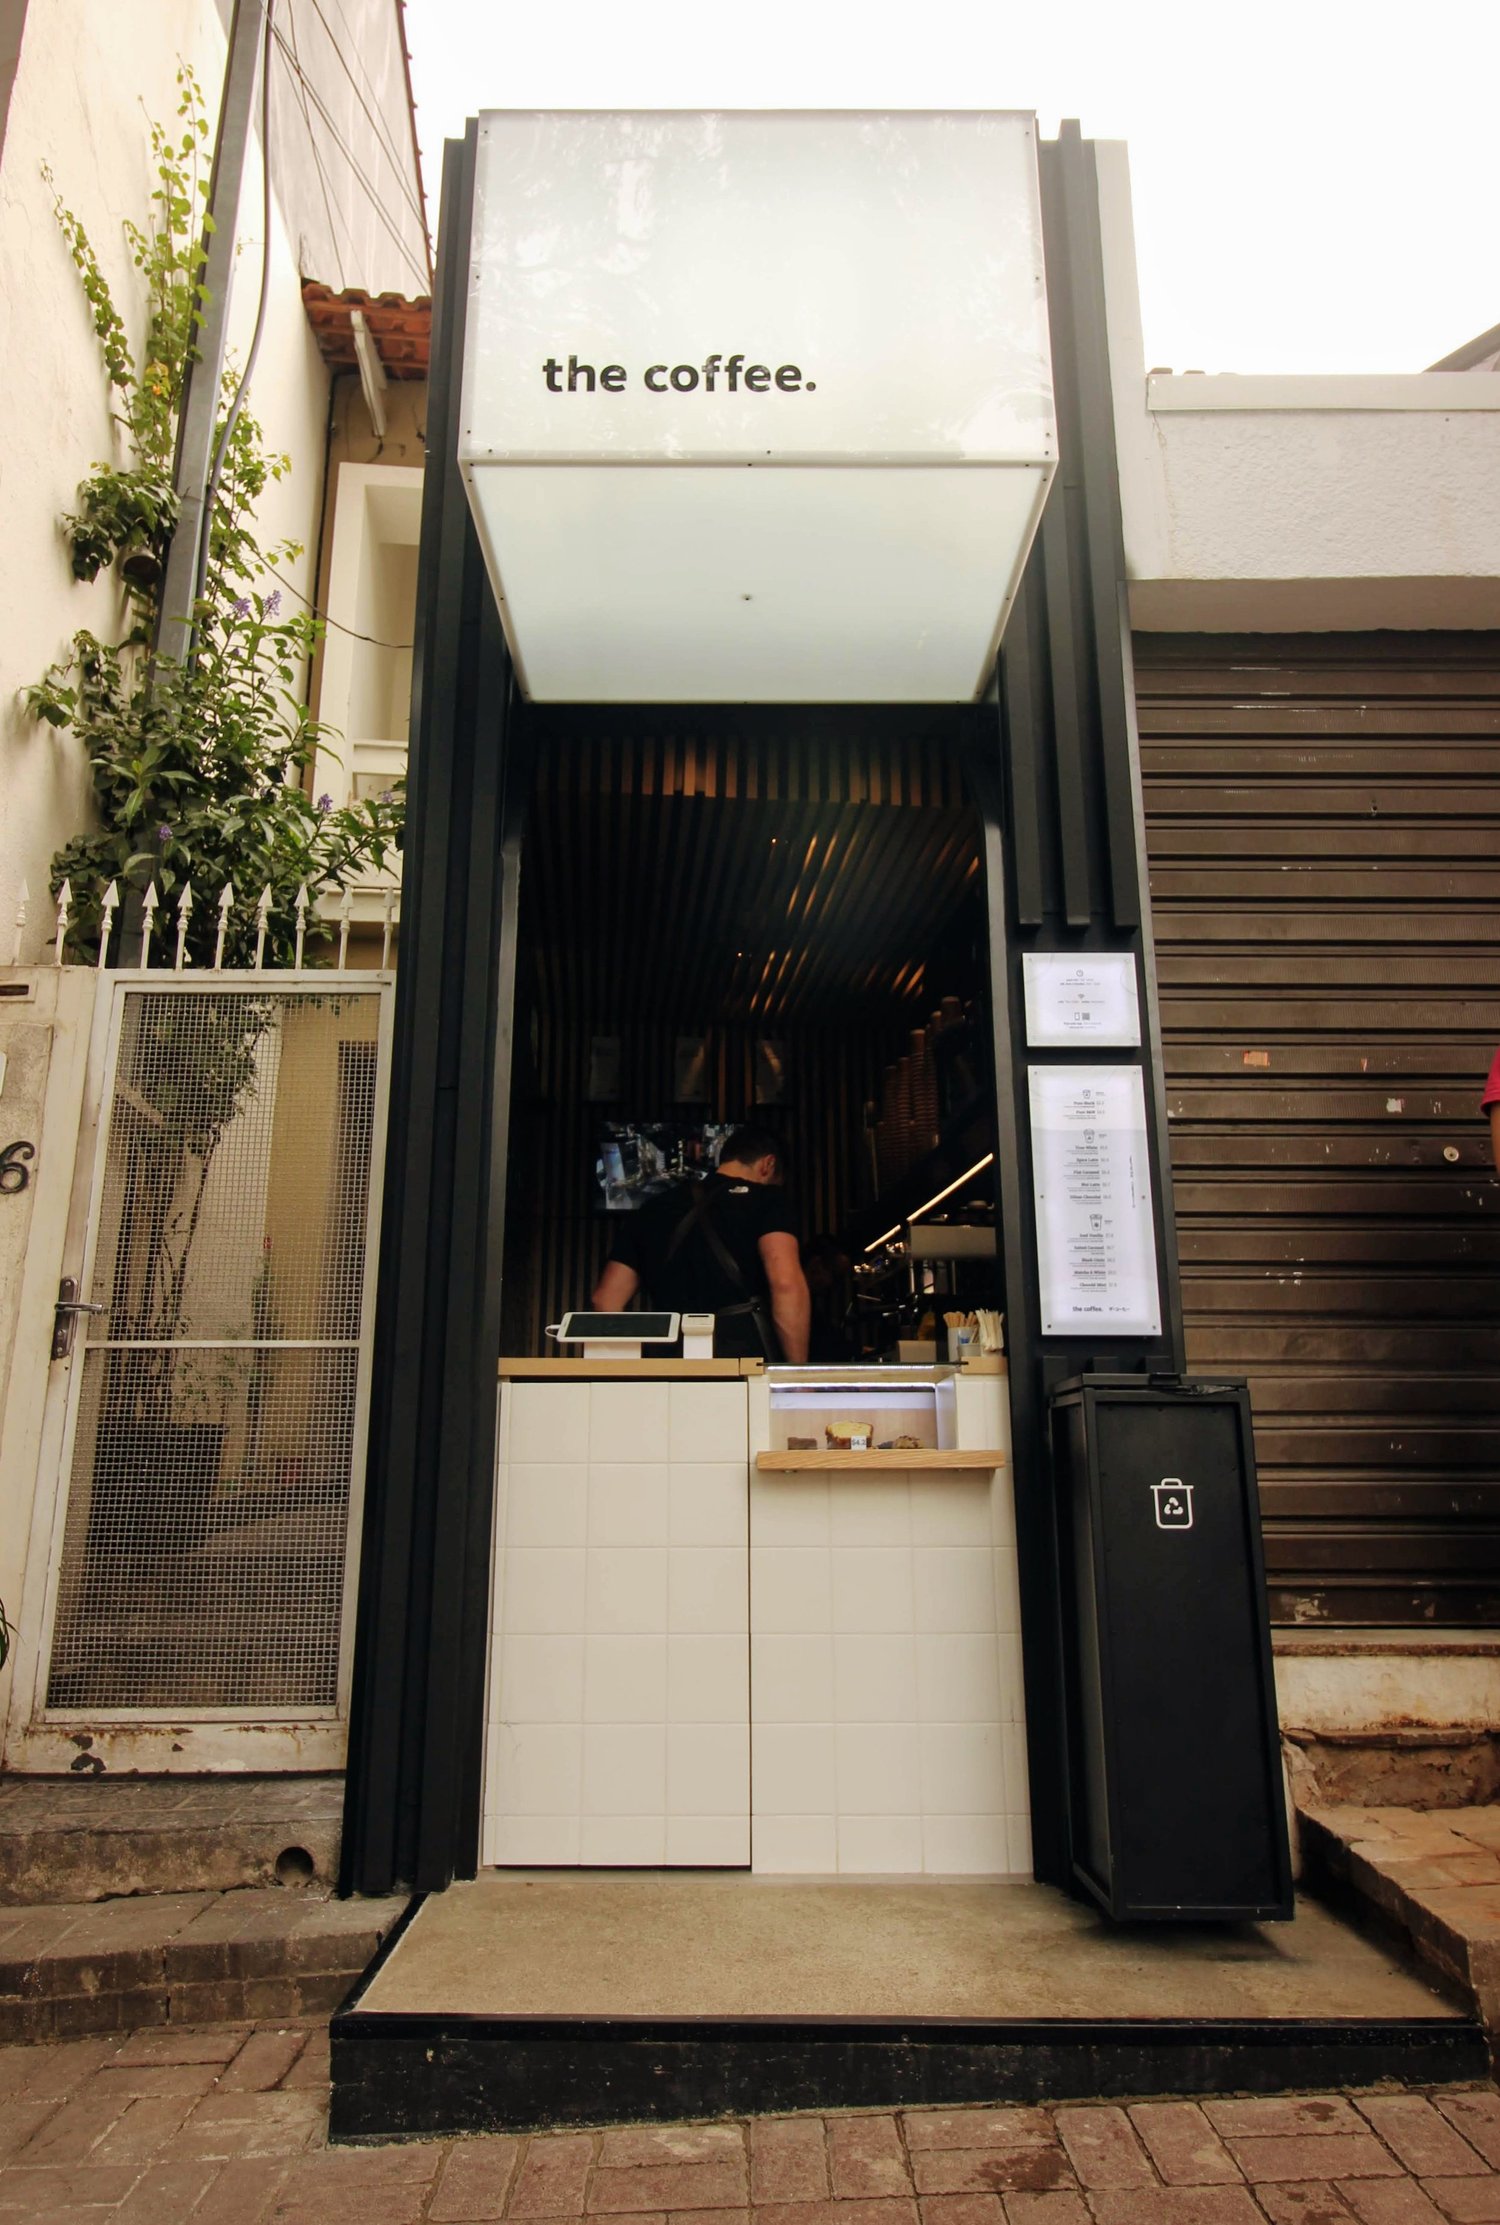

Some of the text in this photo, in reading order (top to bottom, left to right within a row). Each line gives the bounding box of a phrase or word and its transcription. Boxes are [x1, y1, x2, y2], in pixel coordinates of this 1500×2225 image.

[542, 354, 817, 392] the coffee.
[0, 1141, 35, 1194] 6
